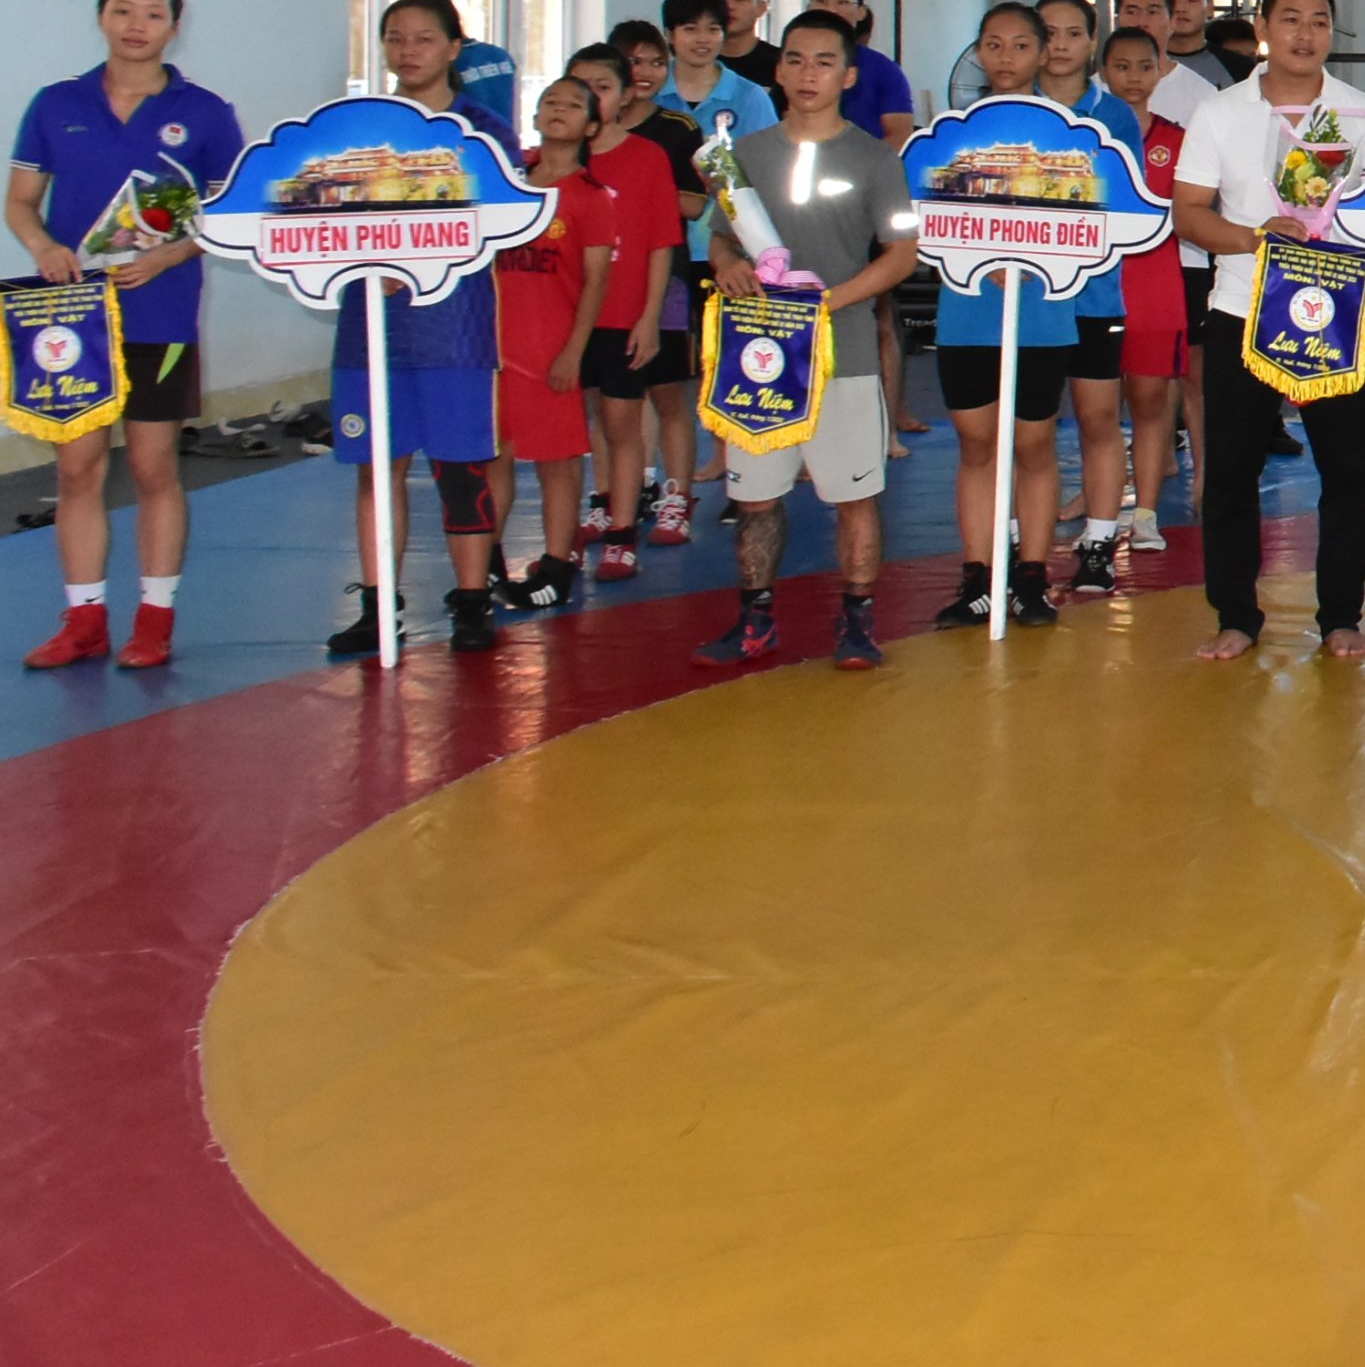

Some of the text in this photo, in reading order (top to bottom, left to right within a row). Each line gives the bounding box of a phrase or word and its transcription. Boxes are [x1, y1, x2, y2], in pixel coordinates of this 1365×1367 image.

[270, 218, 469, 258] HUYỆN PHÚ VANG
[924, 212, 983, 244] HUYỆN
[990, 218, 1051, 245] PHONG
